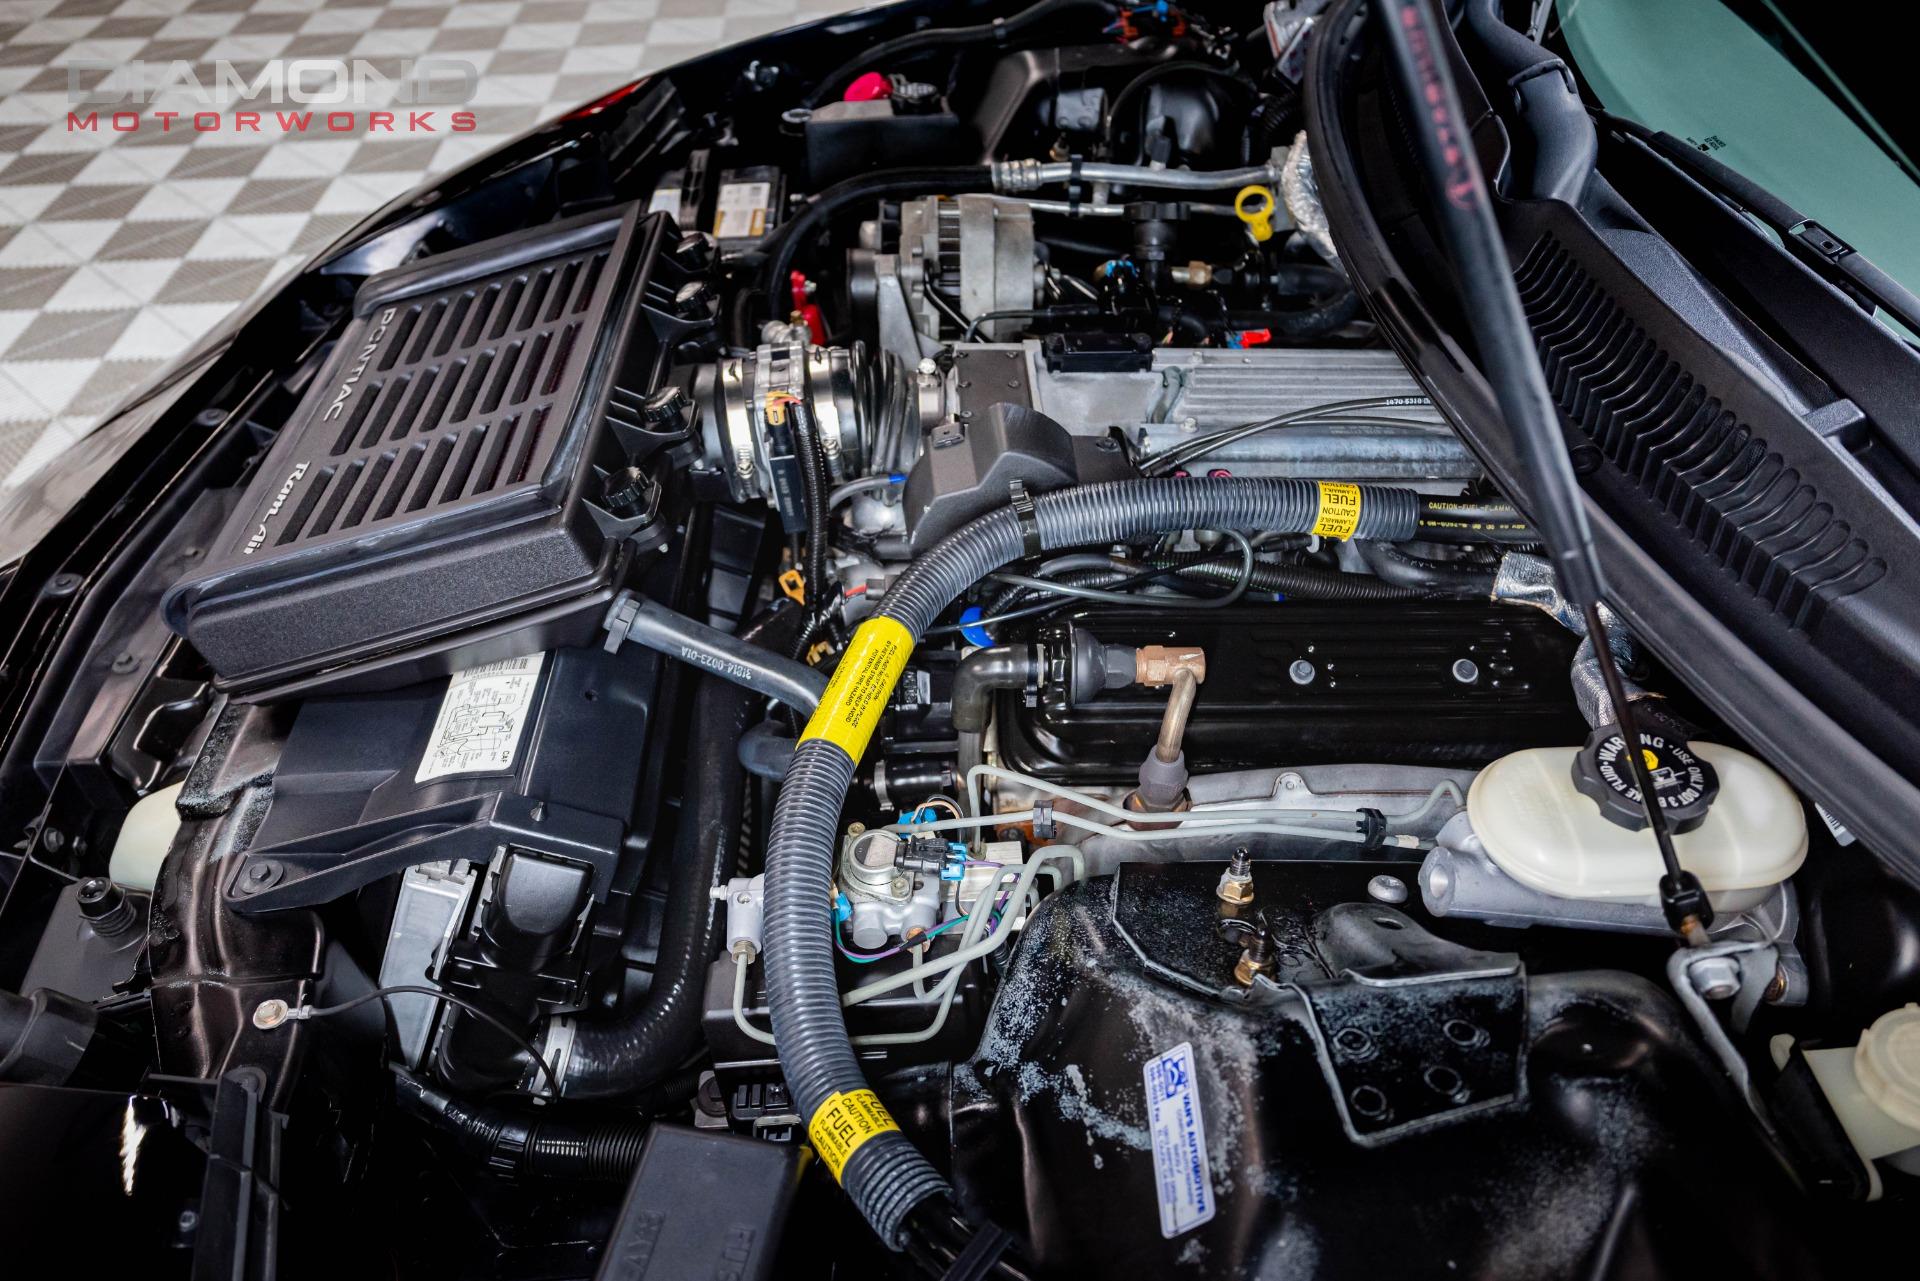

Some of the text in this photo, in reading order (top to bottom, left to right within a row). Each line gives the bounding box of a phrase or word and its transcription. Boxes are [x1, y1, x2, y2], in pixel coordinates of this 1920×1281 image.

[323, 307, 397, 422] PONTIAC
[243, 461, 311, 555] Ram Air
[1322, 506, 1355, 516] CAUTION
[1324, 493, 1355, 505] FUEL
[1319, 523, 1350, 533] FUEL
[872, 646, 888, 670] RETAINER
[864, 670, 875, 686] STRAP
[873, 678, 886, 700] CAUTION
[845, 685, 859, 706] HAZARD
[853, 693, 863, 706] HELP
[845, 706, 857, 722] AVOID
[501, 750, 510, 763] CAF
[1598, 733, 1704, 807] WARNG USE ONLY DOT 3 BKE FLUID
[841, 1096, 872, 1134] CAUTION
[854, 1092, 883, 1129] FLAMMABLE
[864, 1093, 892, 1126] FUEL
[819, 1119, 848, 1156] FLAMMABLE
[826, 1107, 857, 1147] FUEL
[815, 1131, 841, 1168] CAUTION
[1181, 1092, 1204, 1214] VAN'S AUTOMOTIVE
